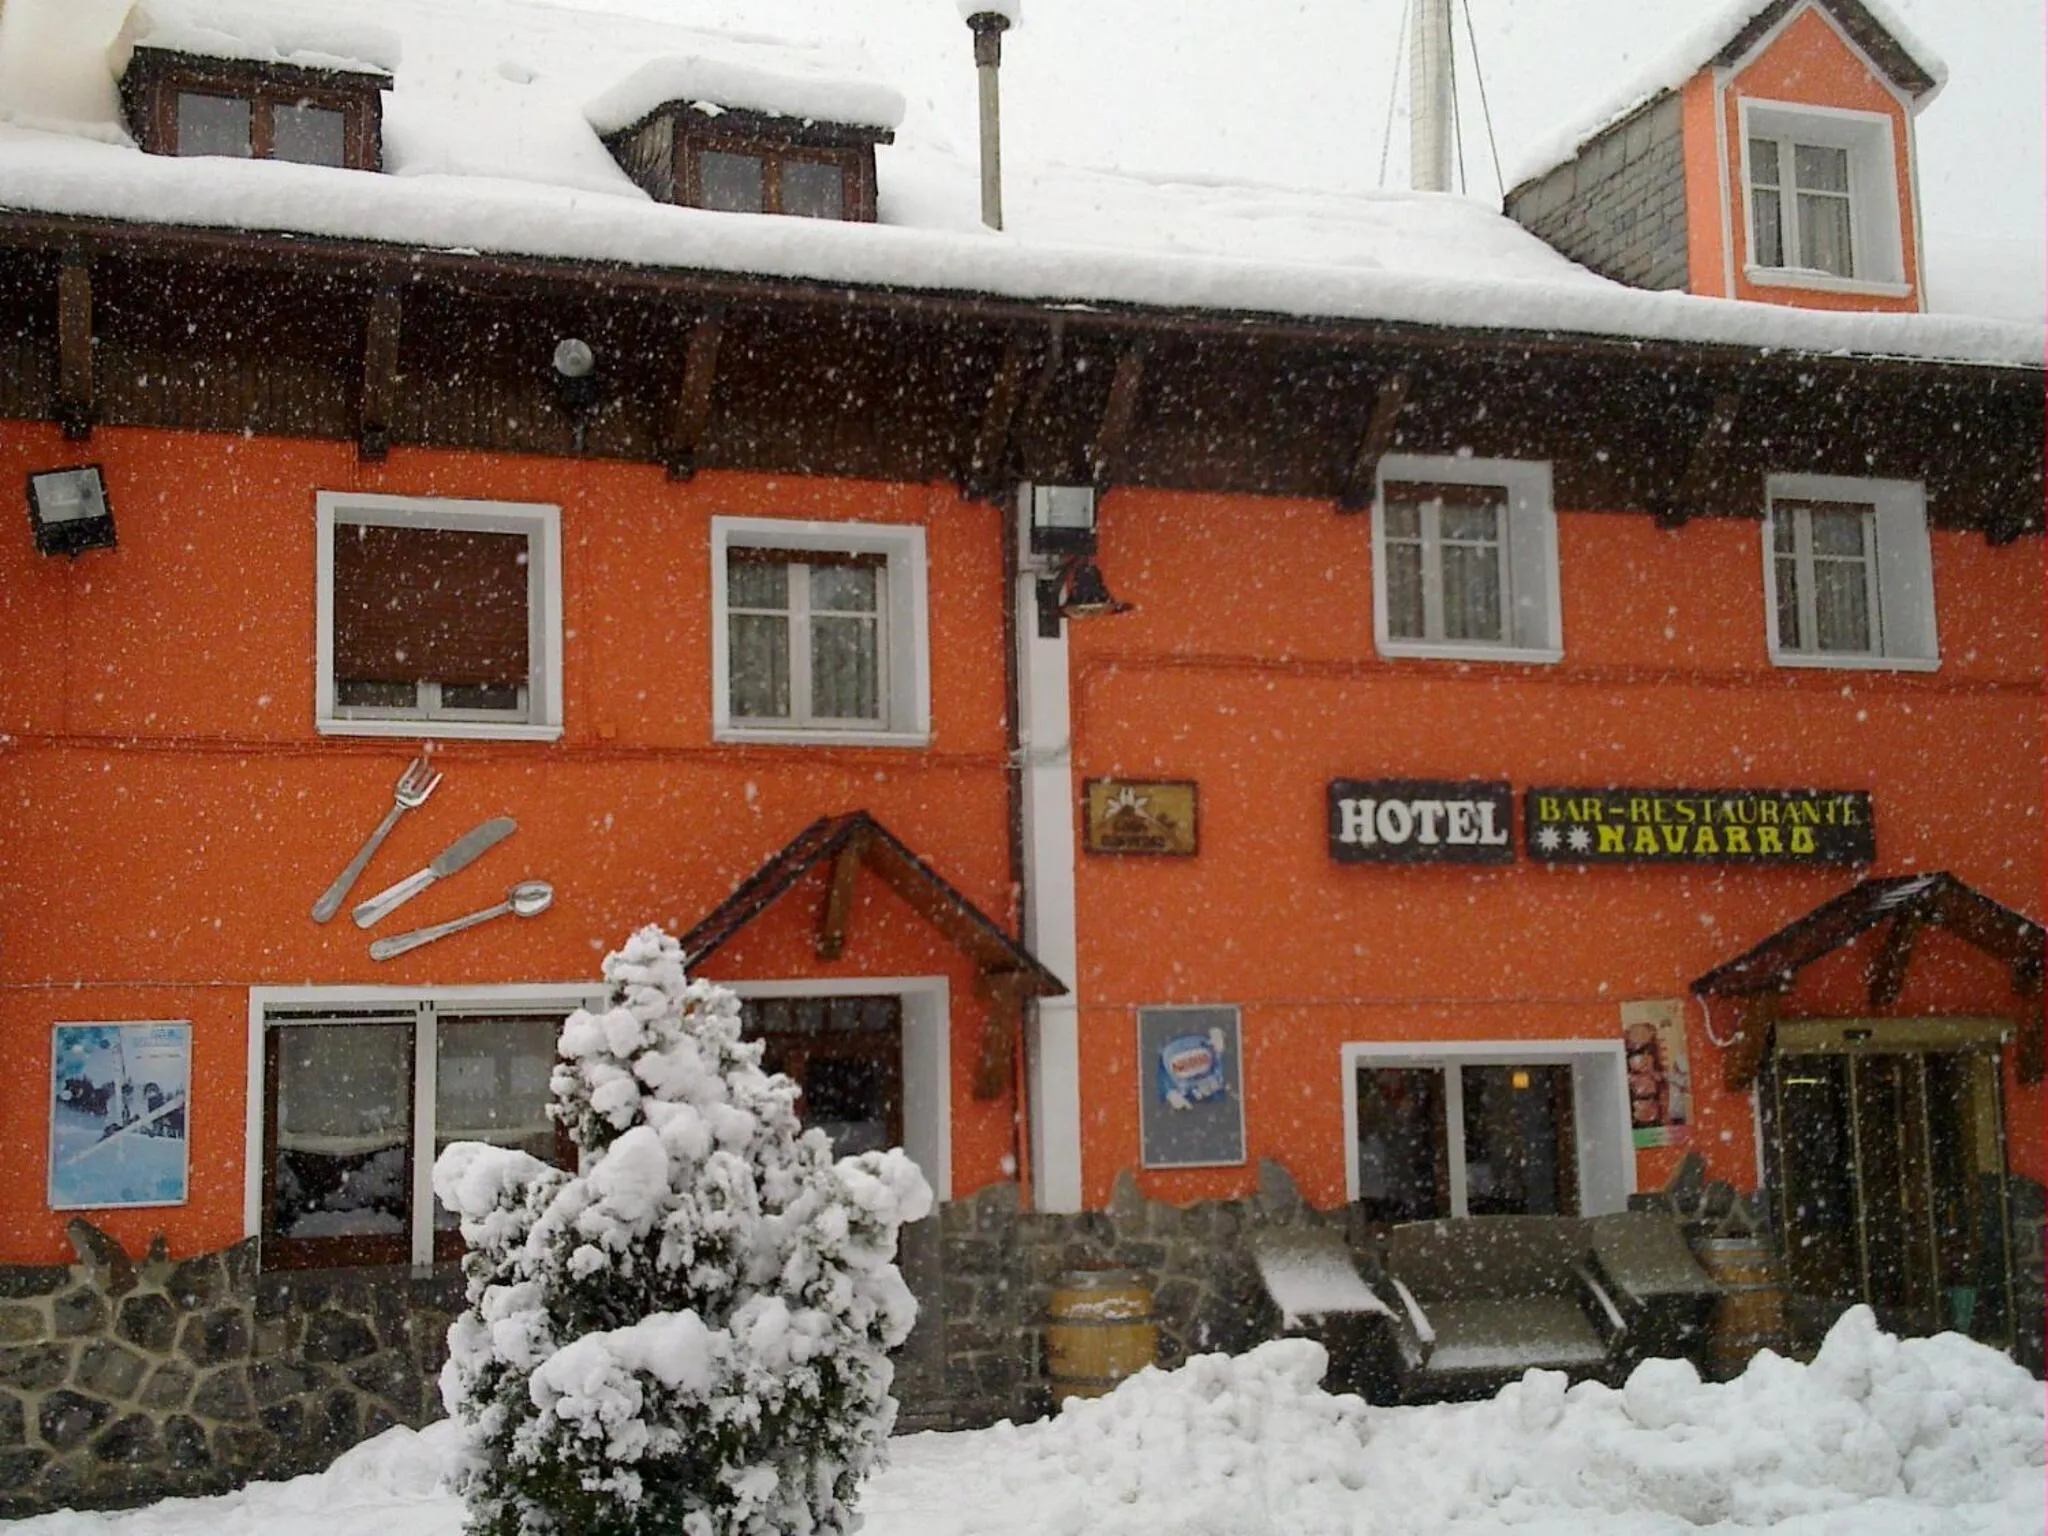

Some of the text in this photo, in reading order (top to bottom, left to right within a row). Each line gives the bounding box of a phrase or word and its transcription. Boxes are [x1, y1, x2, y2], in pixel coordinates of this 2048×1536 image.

[1338, 798, 1509, 846] HOTEL
[1539, 797, 1861, 827] BAR-RESTAURANTE
[1597, 823, 1817, 854] NAVARRO
